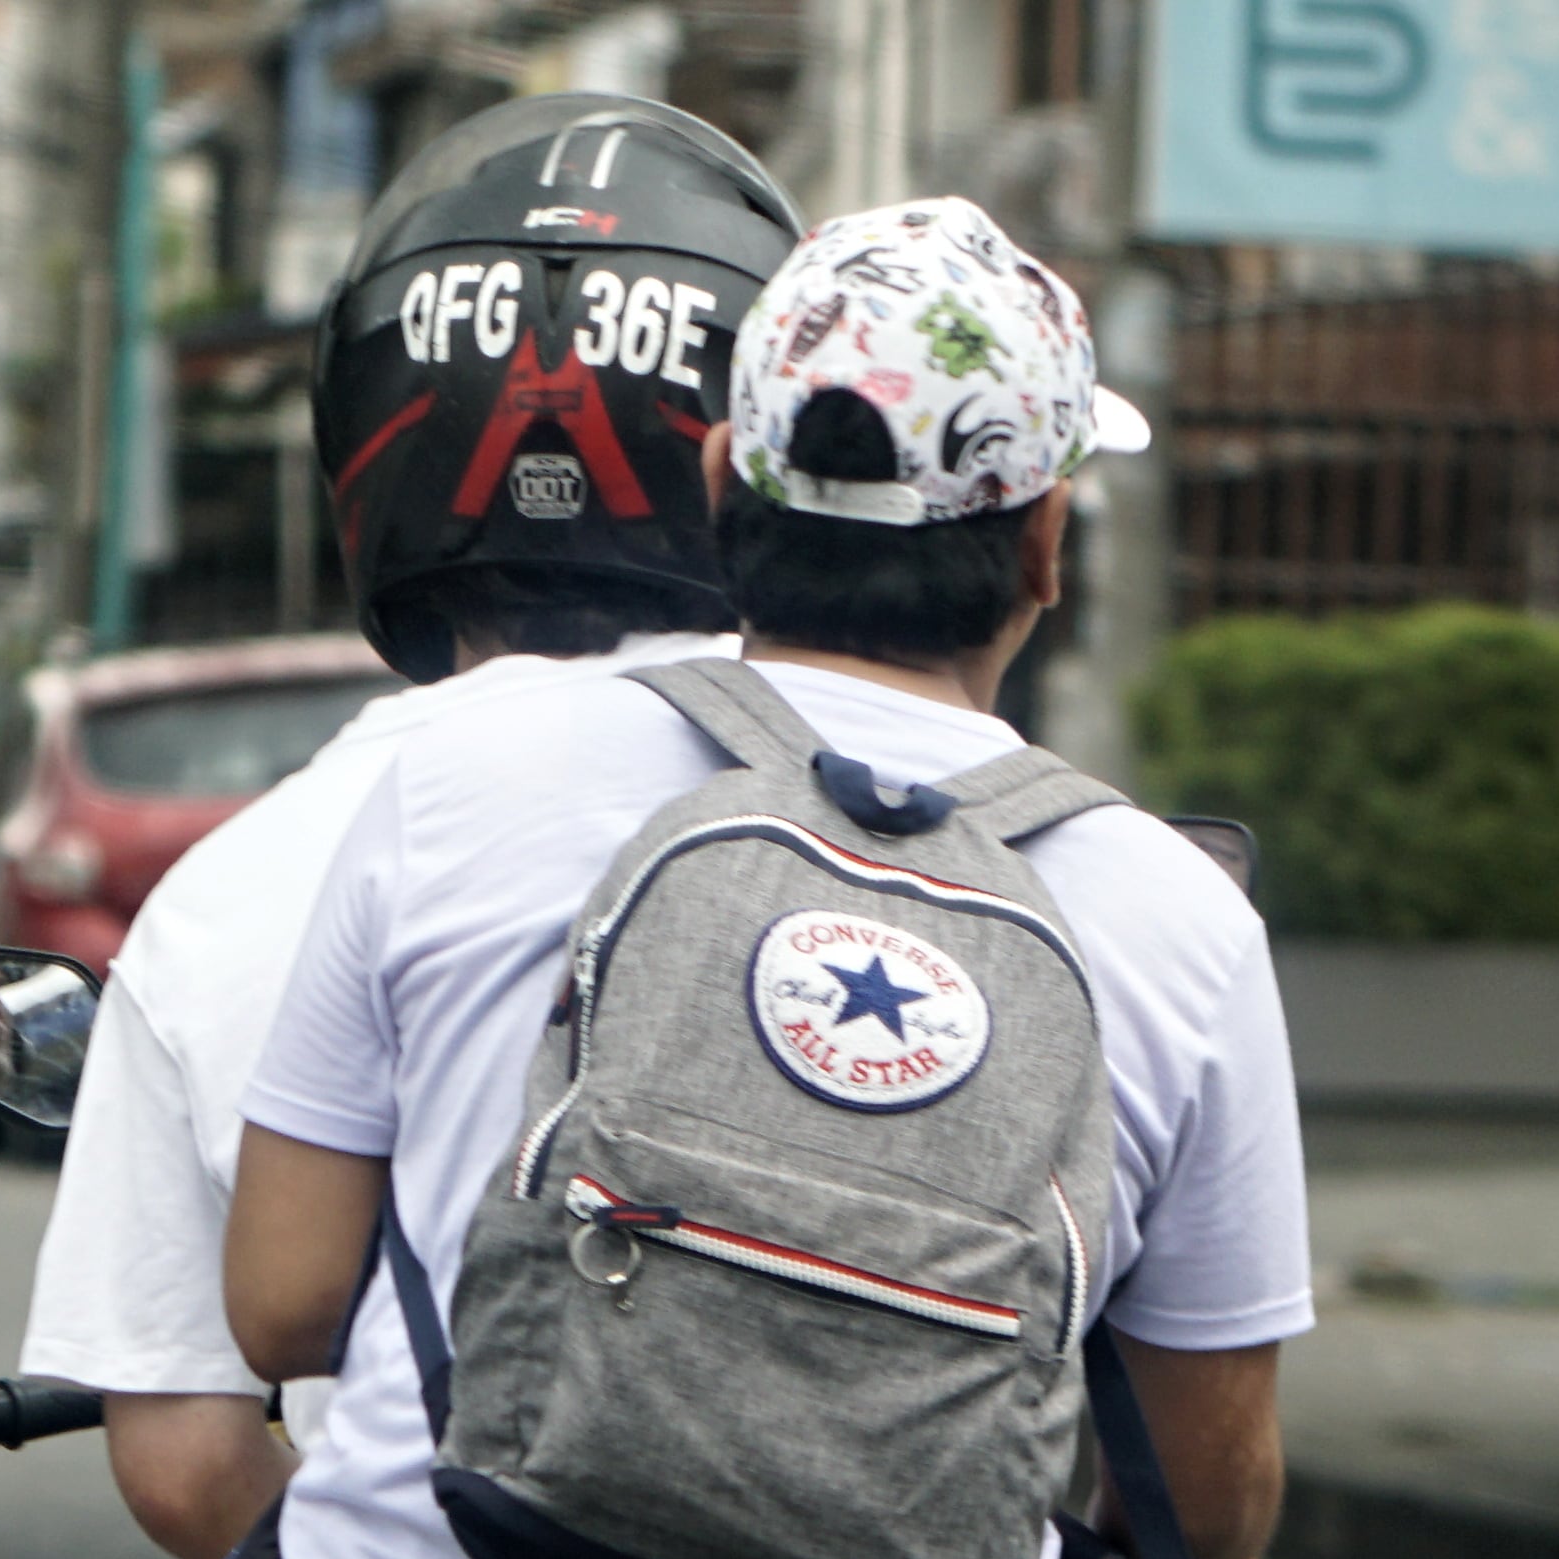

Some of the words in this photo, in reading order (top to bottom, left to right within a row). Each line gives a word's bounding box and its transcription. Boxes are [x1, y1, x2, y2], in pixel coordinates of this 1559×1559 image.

[400, 261, 522, 364] QFG
[573, 270, 716, 390] 36E
[790, 923, 963, 996] CONVERSE
[784, 1018, 837, 1075] ALL
[847, 1046, 944, 1086] STAR
